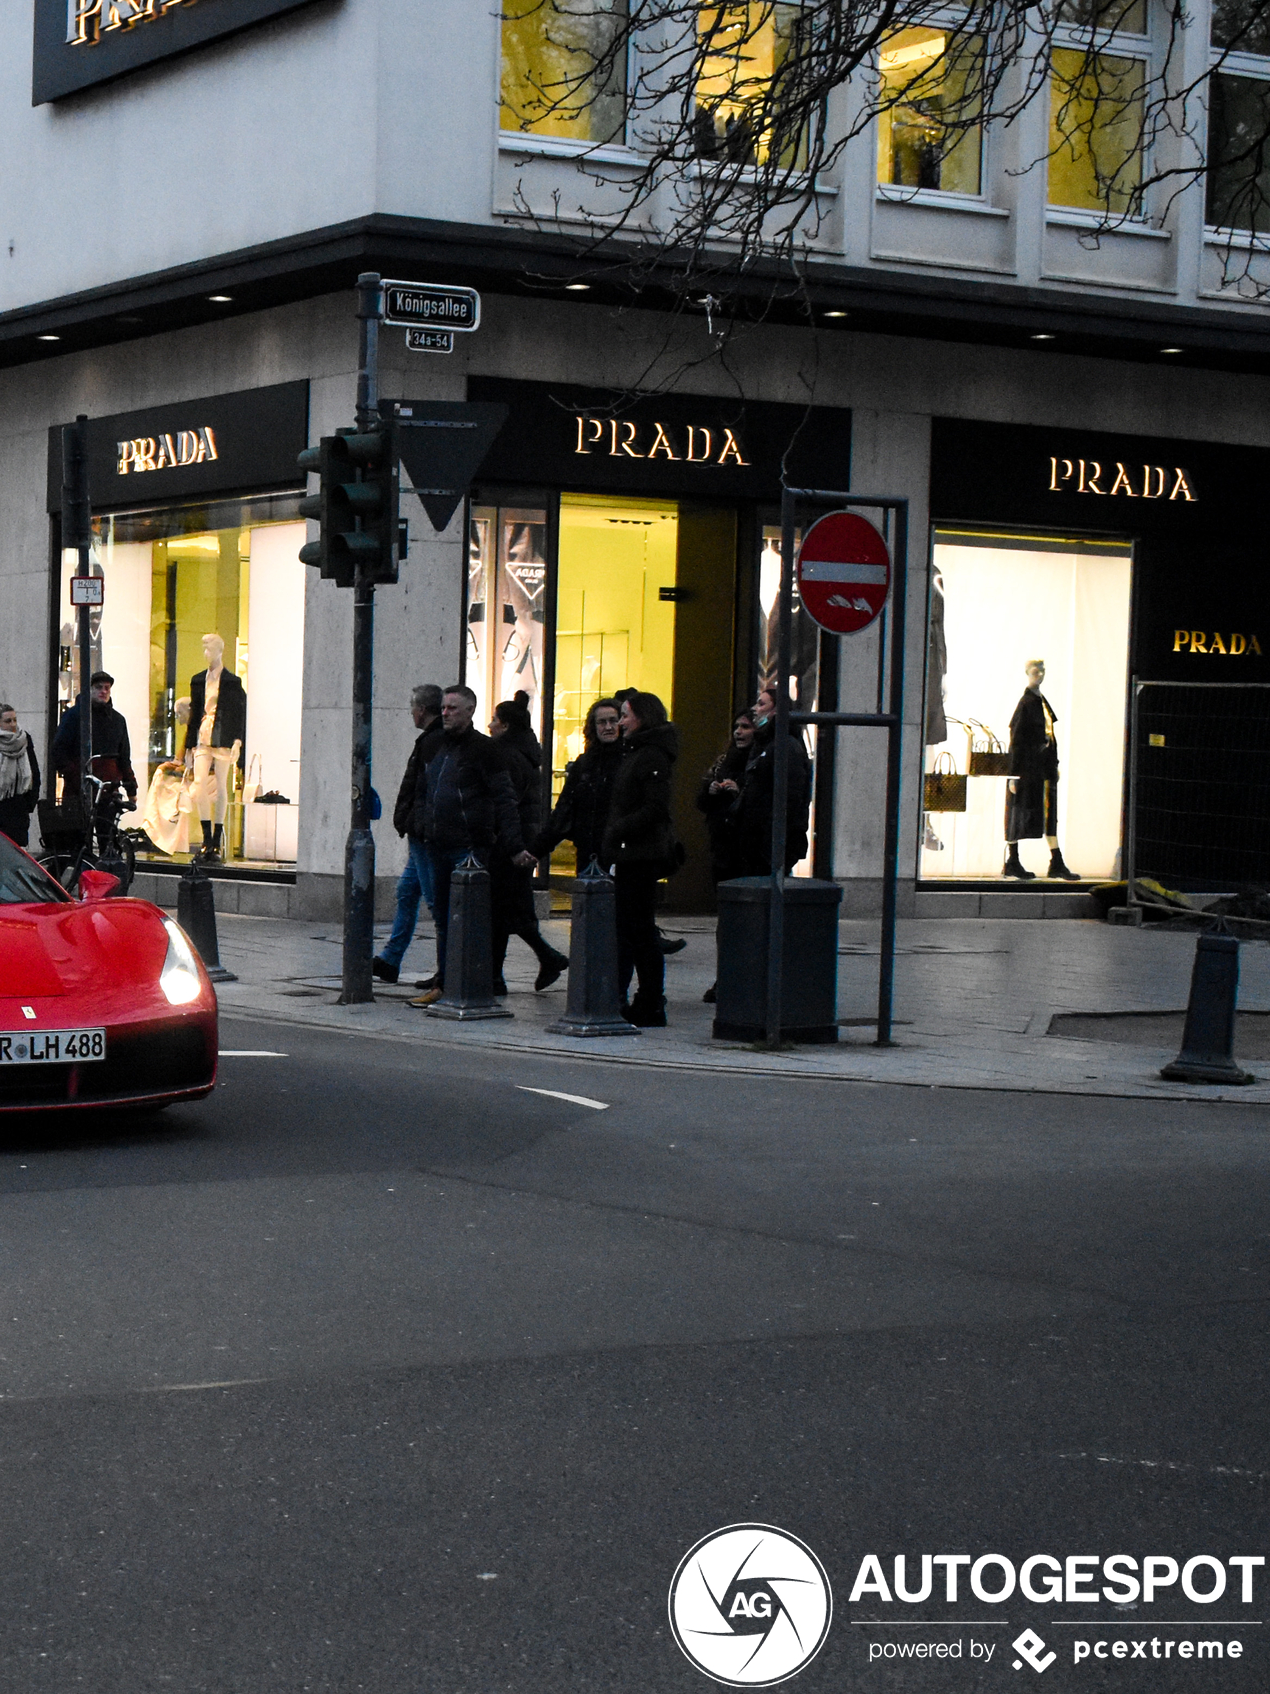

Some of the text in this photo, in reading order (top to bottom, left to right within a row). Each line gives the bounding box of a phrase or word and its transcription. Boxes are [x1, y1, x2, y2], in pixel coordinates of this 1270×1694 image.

[396, 293, 467, 318] Königsallee
[414, 333, 448, 347] 34a-54
[117, 426, 218, 475] PRADA
[575, 416, 751, 466] PRADA
[1049, 456, 1200, 502] PRADA
[1172, 630, 1263, 656] PRADA
[29, 1035, 59, 1060] LH
[65, 1033, 102, 1058] 488
